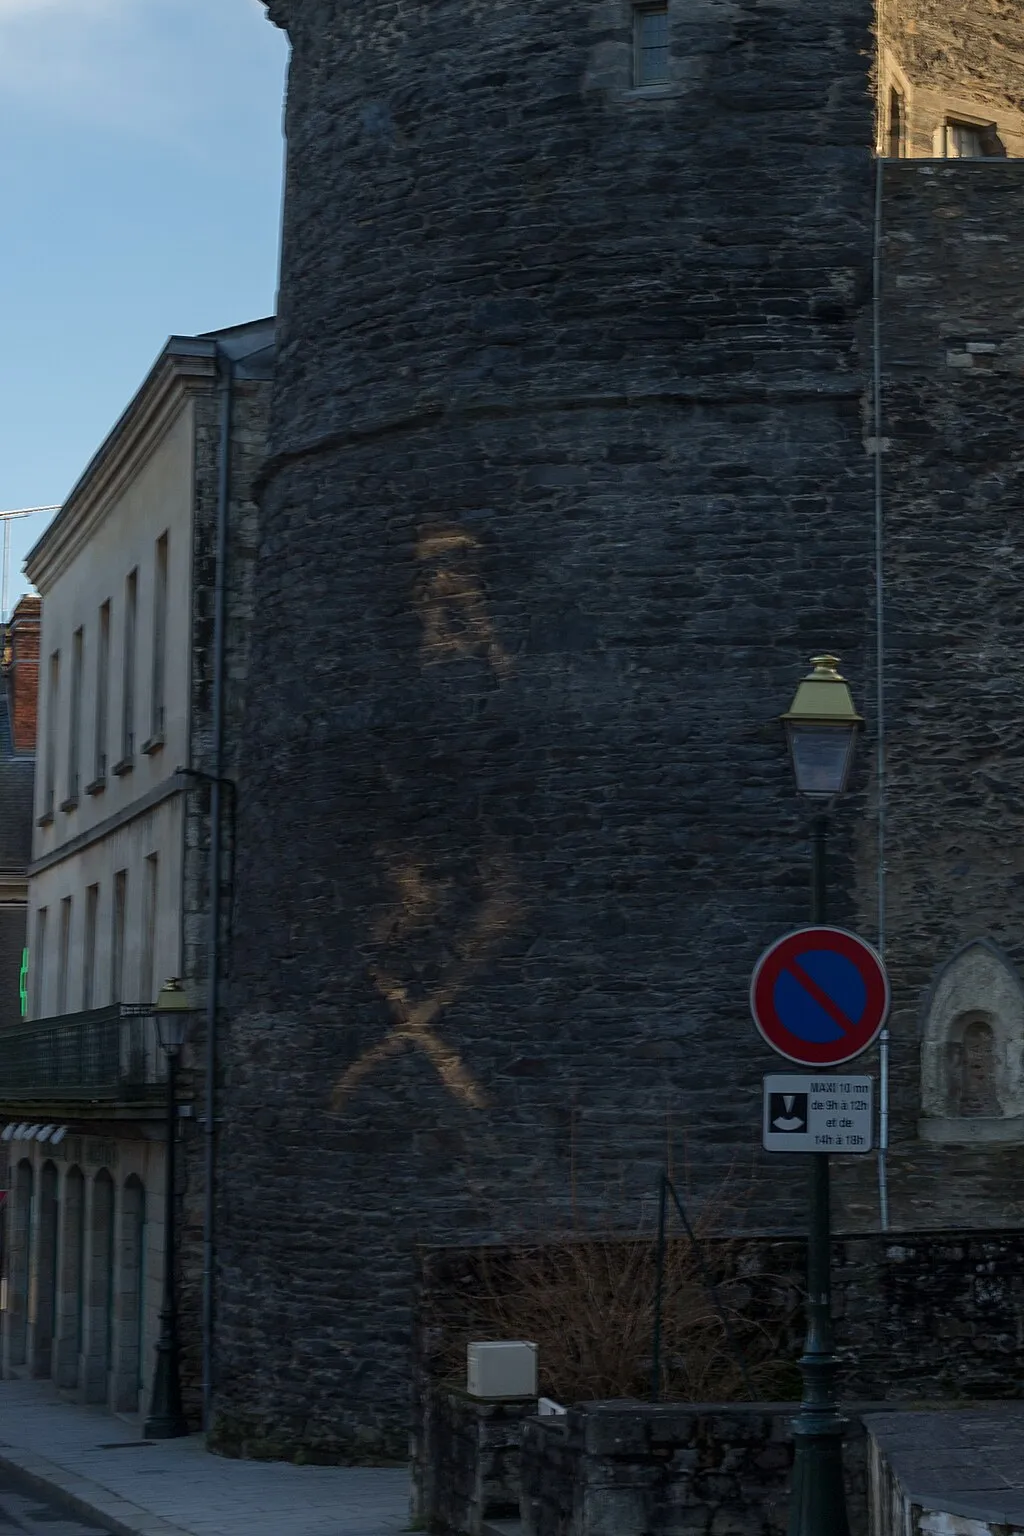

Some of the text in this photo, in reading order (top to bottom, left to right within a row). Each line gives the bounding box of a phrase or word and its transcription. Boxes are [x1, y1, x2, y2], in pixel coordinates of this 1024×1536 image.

[810, 1082, 869, 1093] MAXI 10 mn
[811, 1100, 868, 1110] de 9h à 12h
[826, 1117, 853, 1128] et de
[814, 1135, 864, 1145] 14h à 18h
